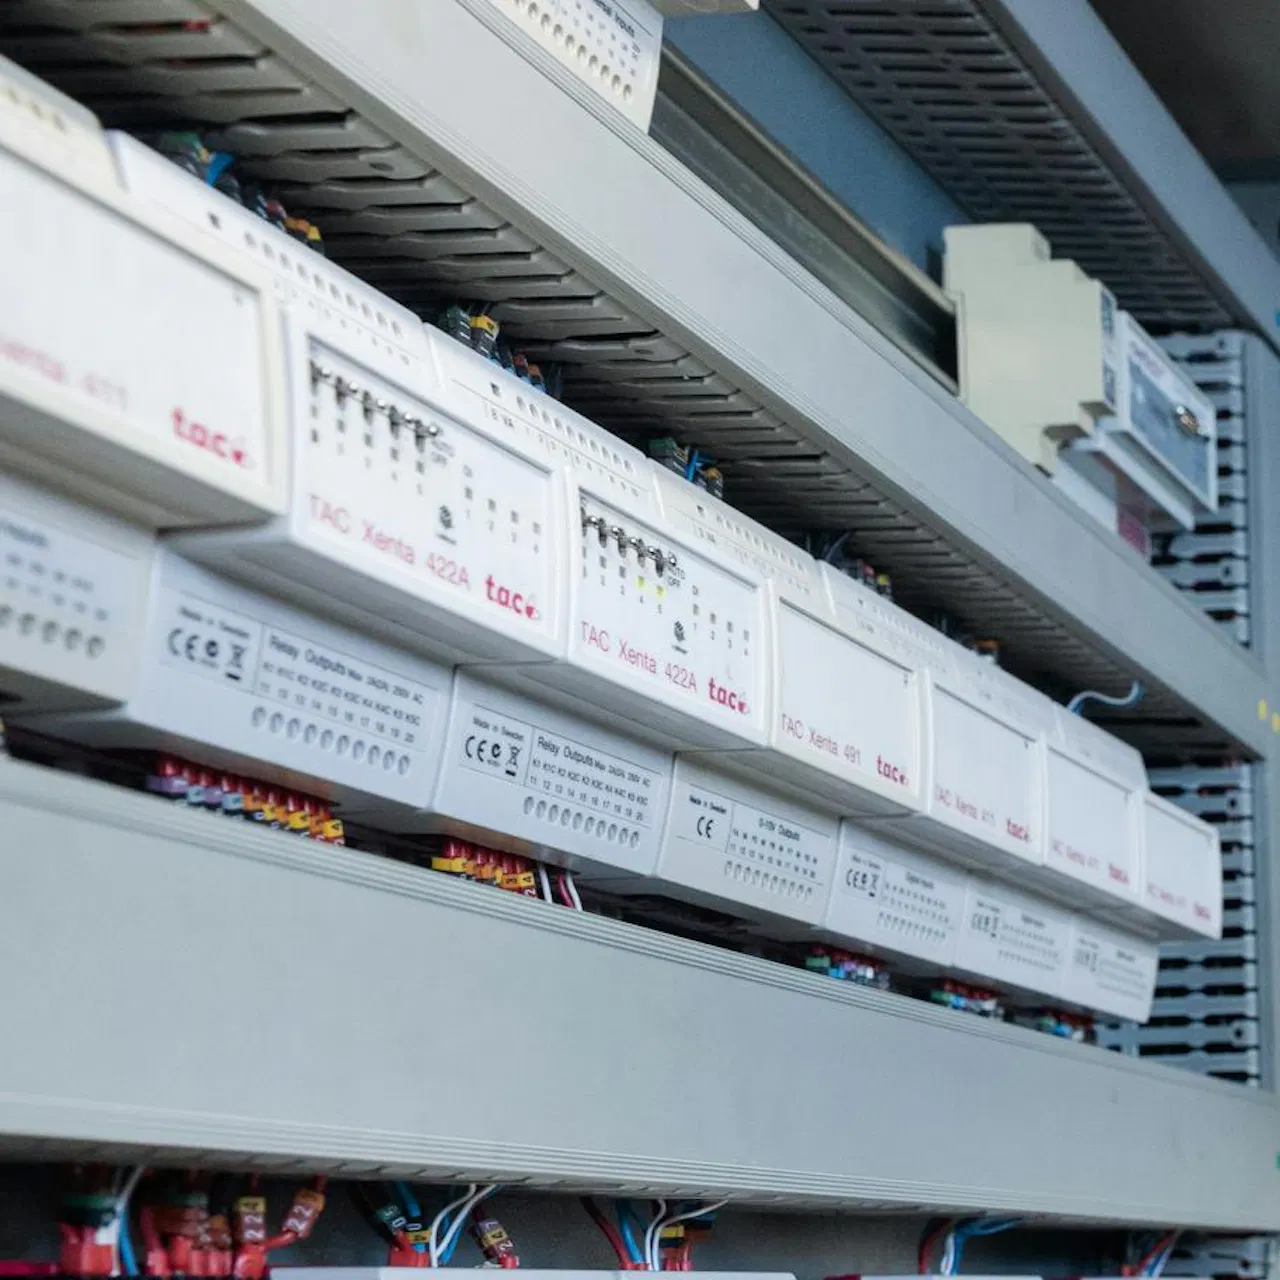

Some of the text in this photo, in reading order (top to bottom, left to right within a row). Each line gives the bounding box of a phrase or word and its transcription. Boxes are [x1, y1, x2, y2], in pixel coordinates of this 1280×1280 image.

[171, 406, 227, 459] tac
[309, 494, 470, 591] TAC Xenta 422A
[484, 573, 523, 616] tac
[305, 648, 346, 676] Outputs
[580, 621, 699, 692] TAC Xenta 422A
[708, 676, 738, 711] tac
[537, 736, 560, 758] Relay
[564, 745, 594, 768] Outputs
[782, 712, 862, 766] TAC Xenta 491
[876, 752, 899, 785] tac
[697, 816, 714, 839] CE
